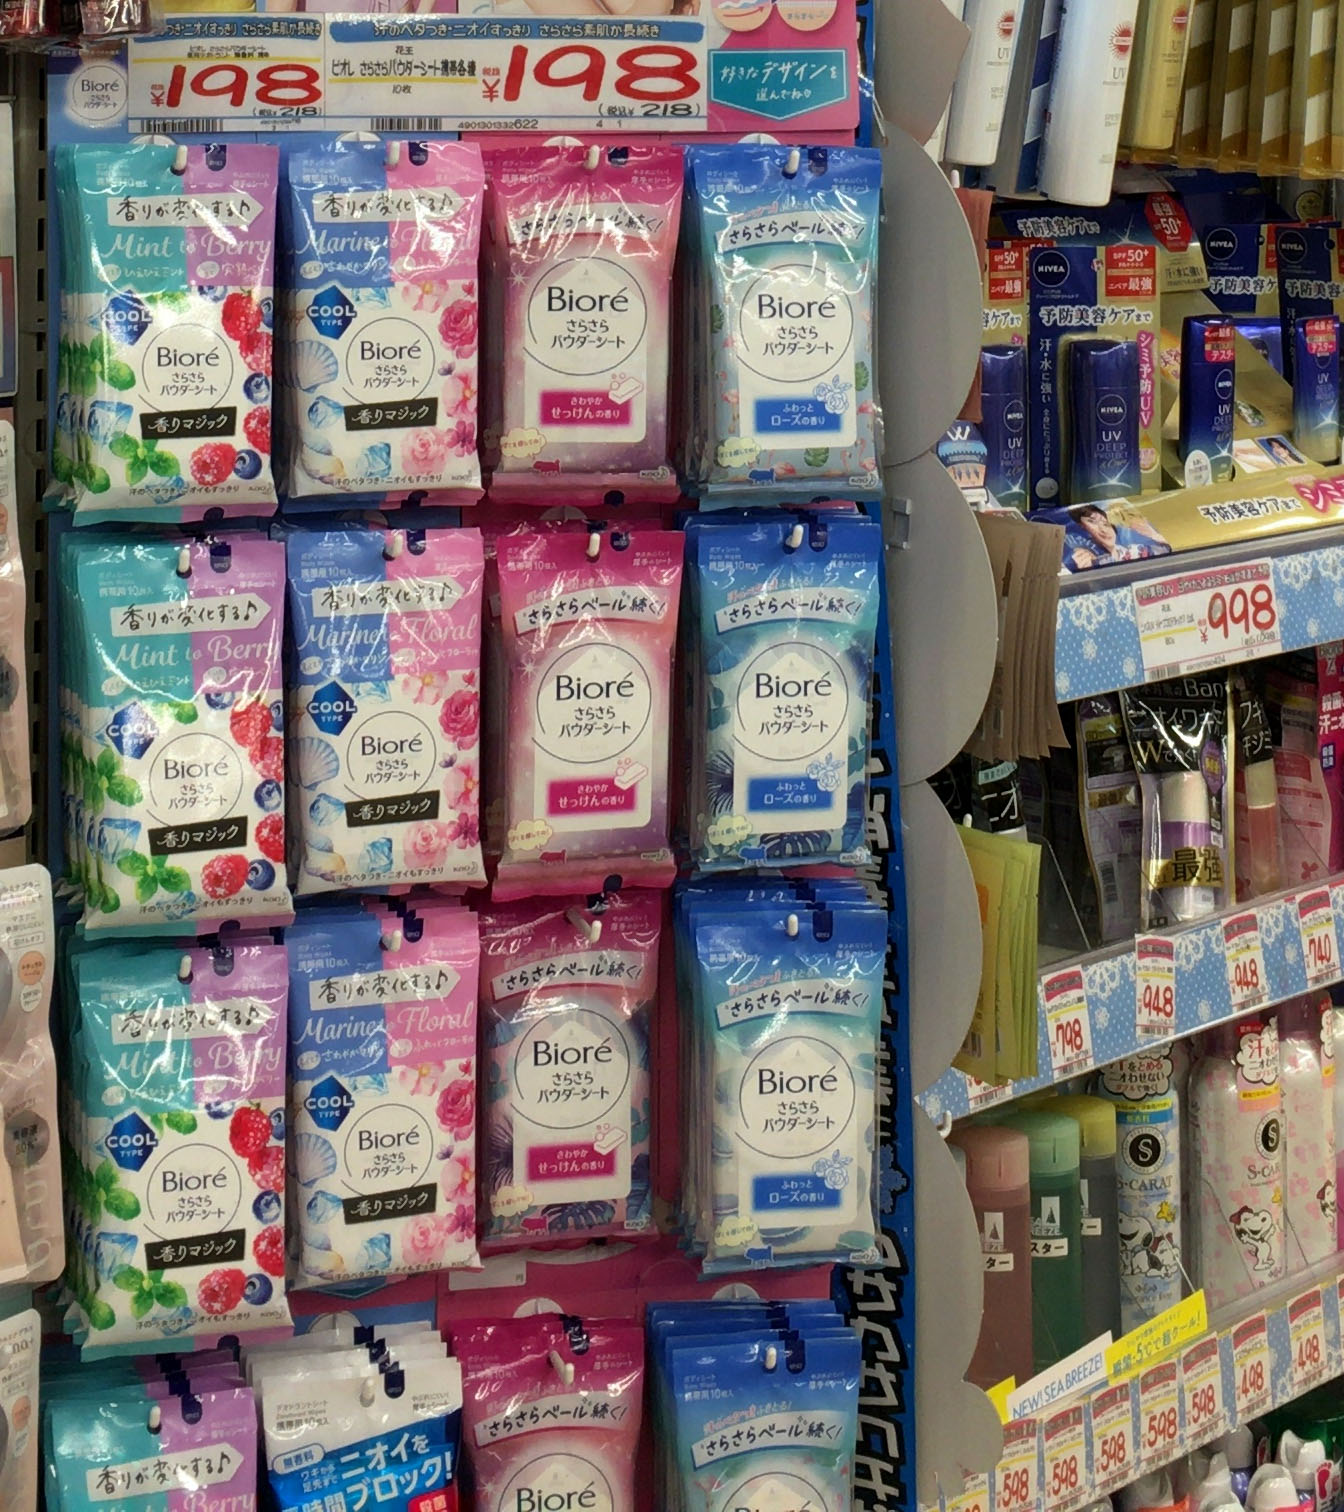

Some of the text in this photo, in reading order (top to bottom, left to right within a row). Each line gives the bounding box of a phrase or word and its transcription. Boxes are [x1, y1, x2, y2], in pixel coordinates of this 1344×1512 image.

[166, 63, 322, 107] 198
[503, 45, 701, 102] 198
[1038, 265, 1065, 273] NIVEA
[1208, 583, 1276, 637] 998
